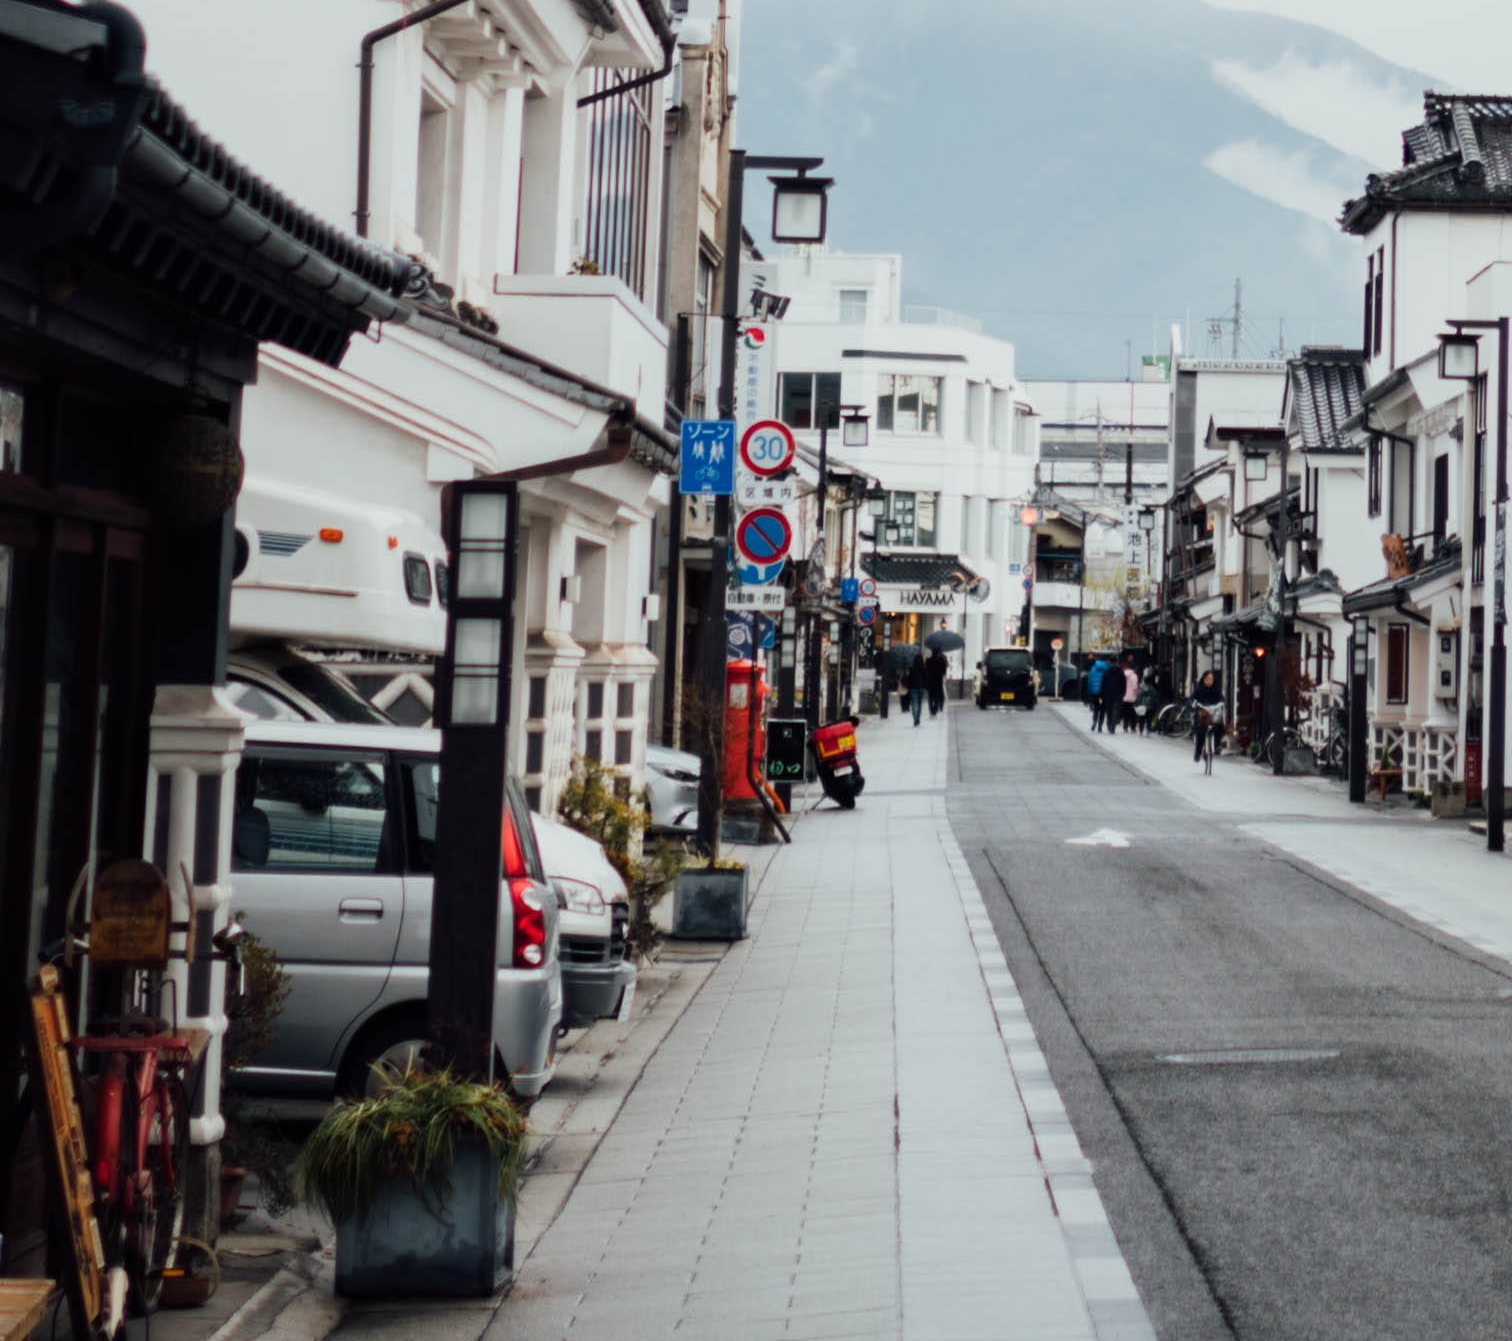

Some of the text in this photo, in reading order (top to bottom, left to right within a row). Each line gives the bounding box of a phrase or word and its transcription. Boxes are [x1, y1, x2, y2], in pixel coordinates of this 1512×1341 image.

[687, 424, 730, 440] ゾーン
[753, 436, 785, 461] 30
[899, 590, 956, 606] HAYAMA
